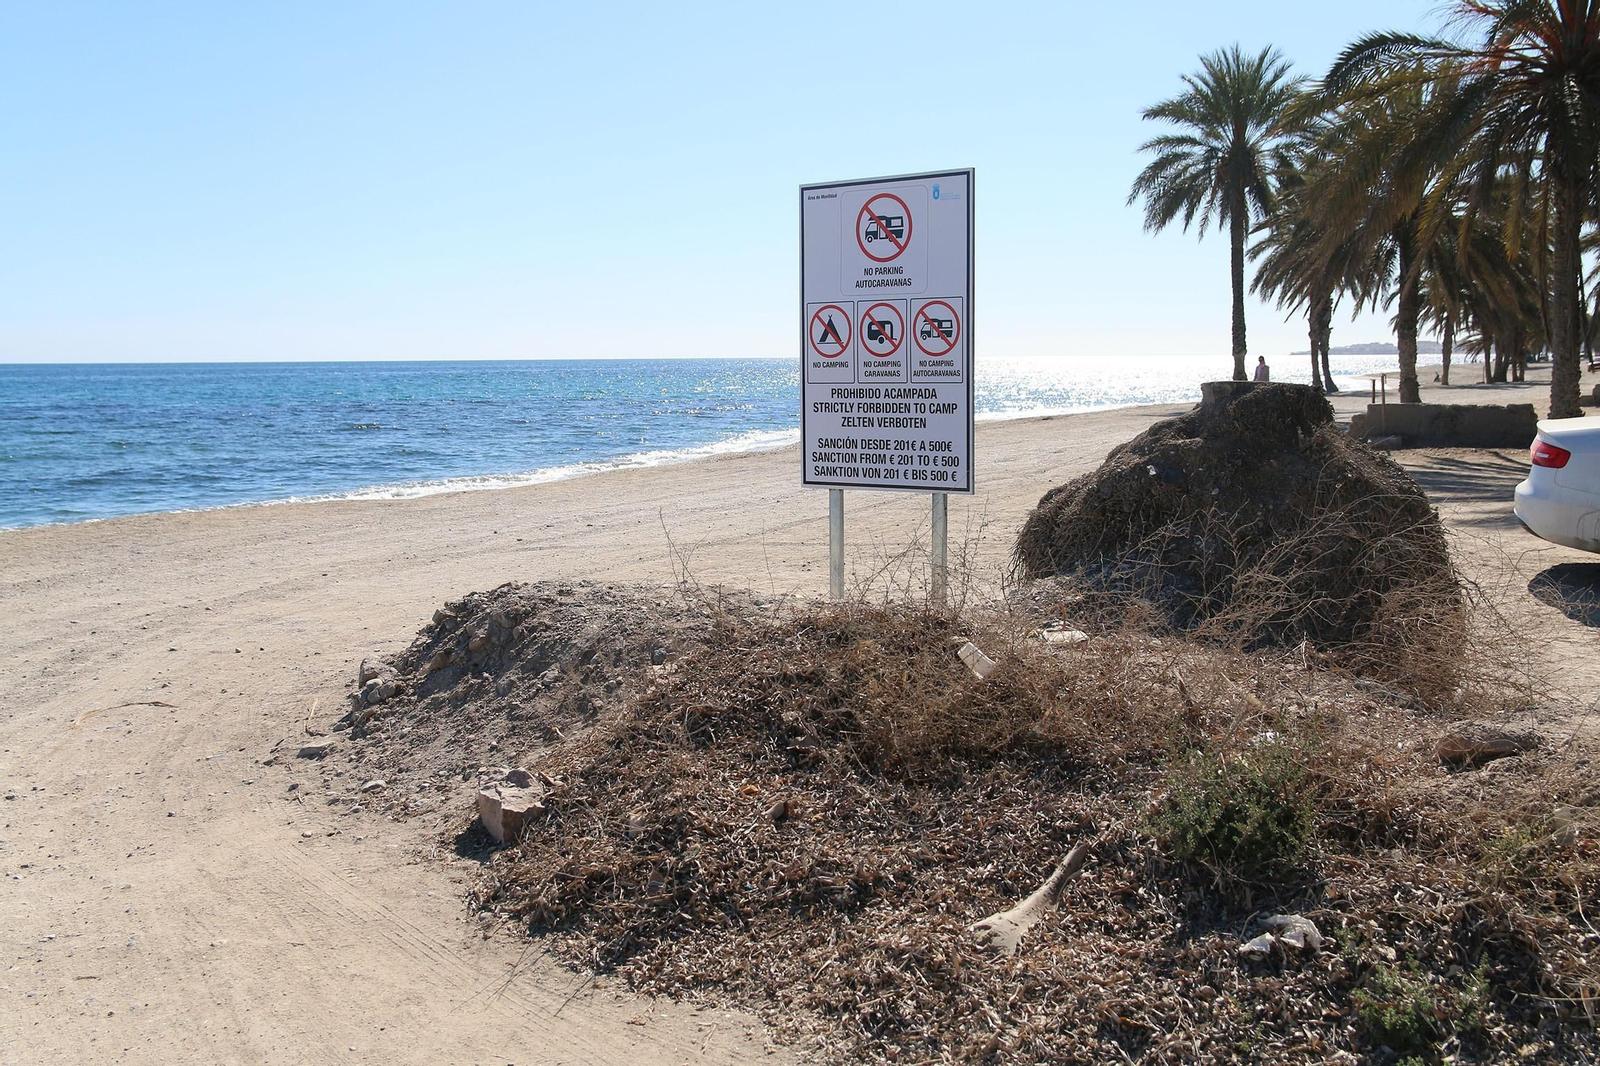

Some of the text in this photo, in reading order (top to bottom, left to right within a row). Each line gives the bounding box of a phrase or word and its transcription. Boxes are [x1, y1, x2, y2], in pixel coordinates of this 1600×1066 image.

[864, 266, 903, 276] NO PARKING
[855, 278, 912, 288] AUTOCARAVANAS
[831, 388, 937, 399] PROHIBIDO ACAMPADA
[813, 402, 958, 414] STRICTLY FORBIDDEN TO CAMP
[841, 417, 926, 428] ZELTEN VERBOTEN
[818, 436, 858, 449] SANCIÓN
[861, 439, 890, 450] DESDE
[920, 440, 926, 451] A
[929, 441, 952, 452] 500€
[812, 452, 857, 463] SANCTION
[860, 453, 886, 464] FROM
[898, 455, 913, 465] 201
[918, 455, 929, 466] TO
[941, 456, 959, 467] 500
[814, 466, 859, 477] SANKTION
[862, 468, 880, 478] VON
[884, 468, 899, 479] 201
[912, 470, 927, 480] BIS
[930, 470, 948, 481] 500
